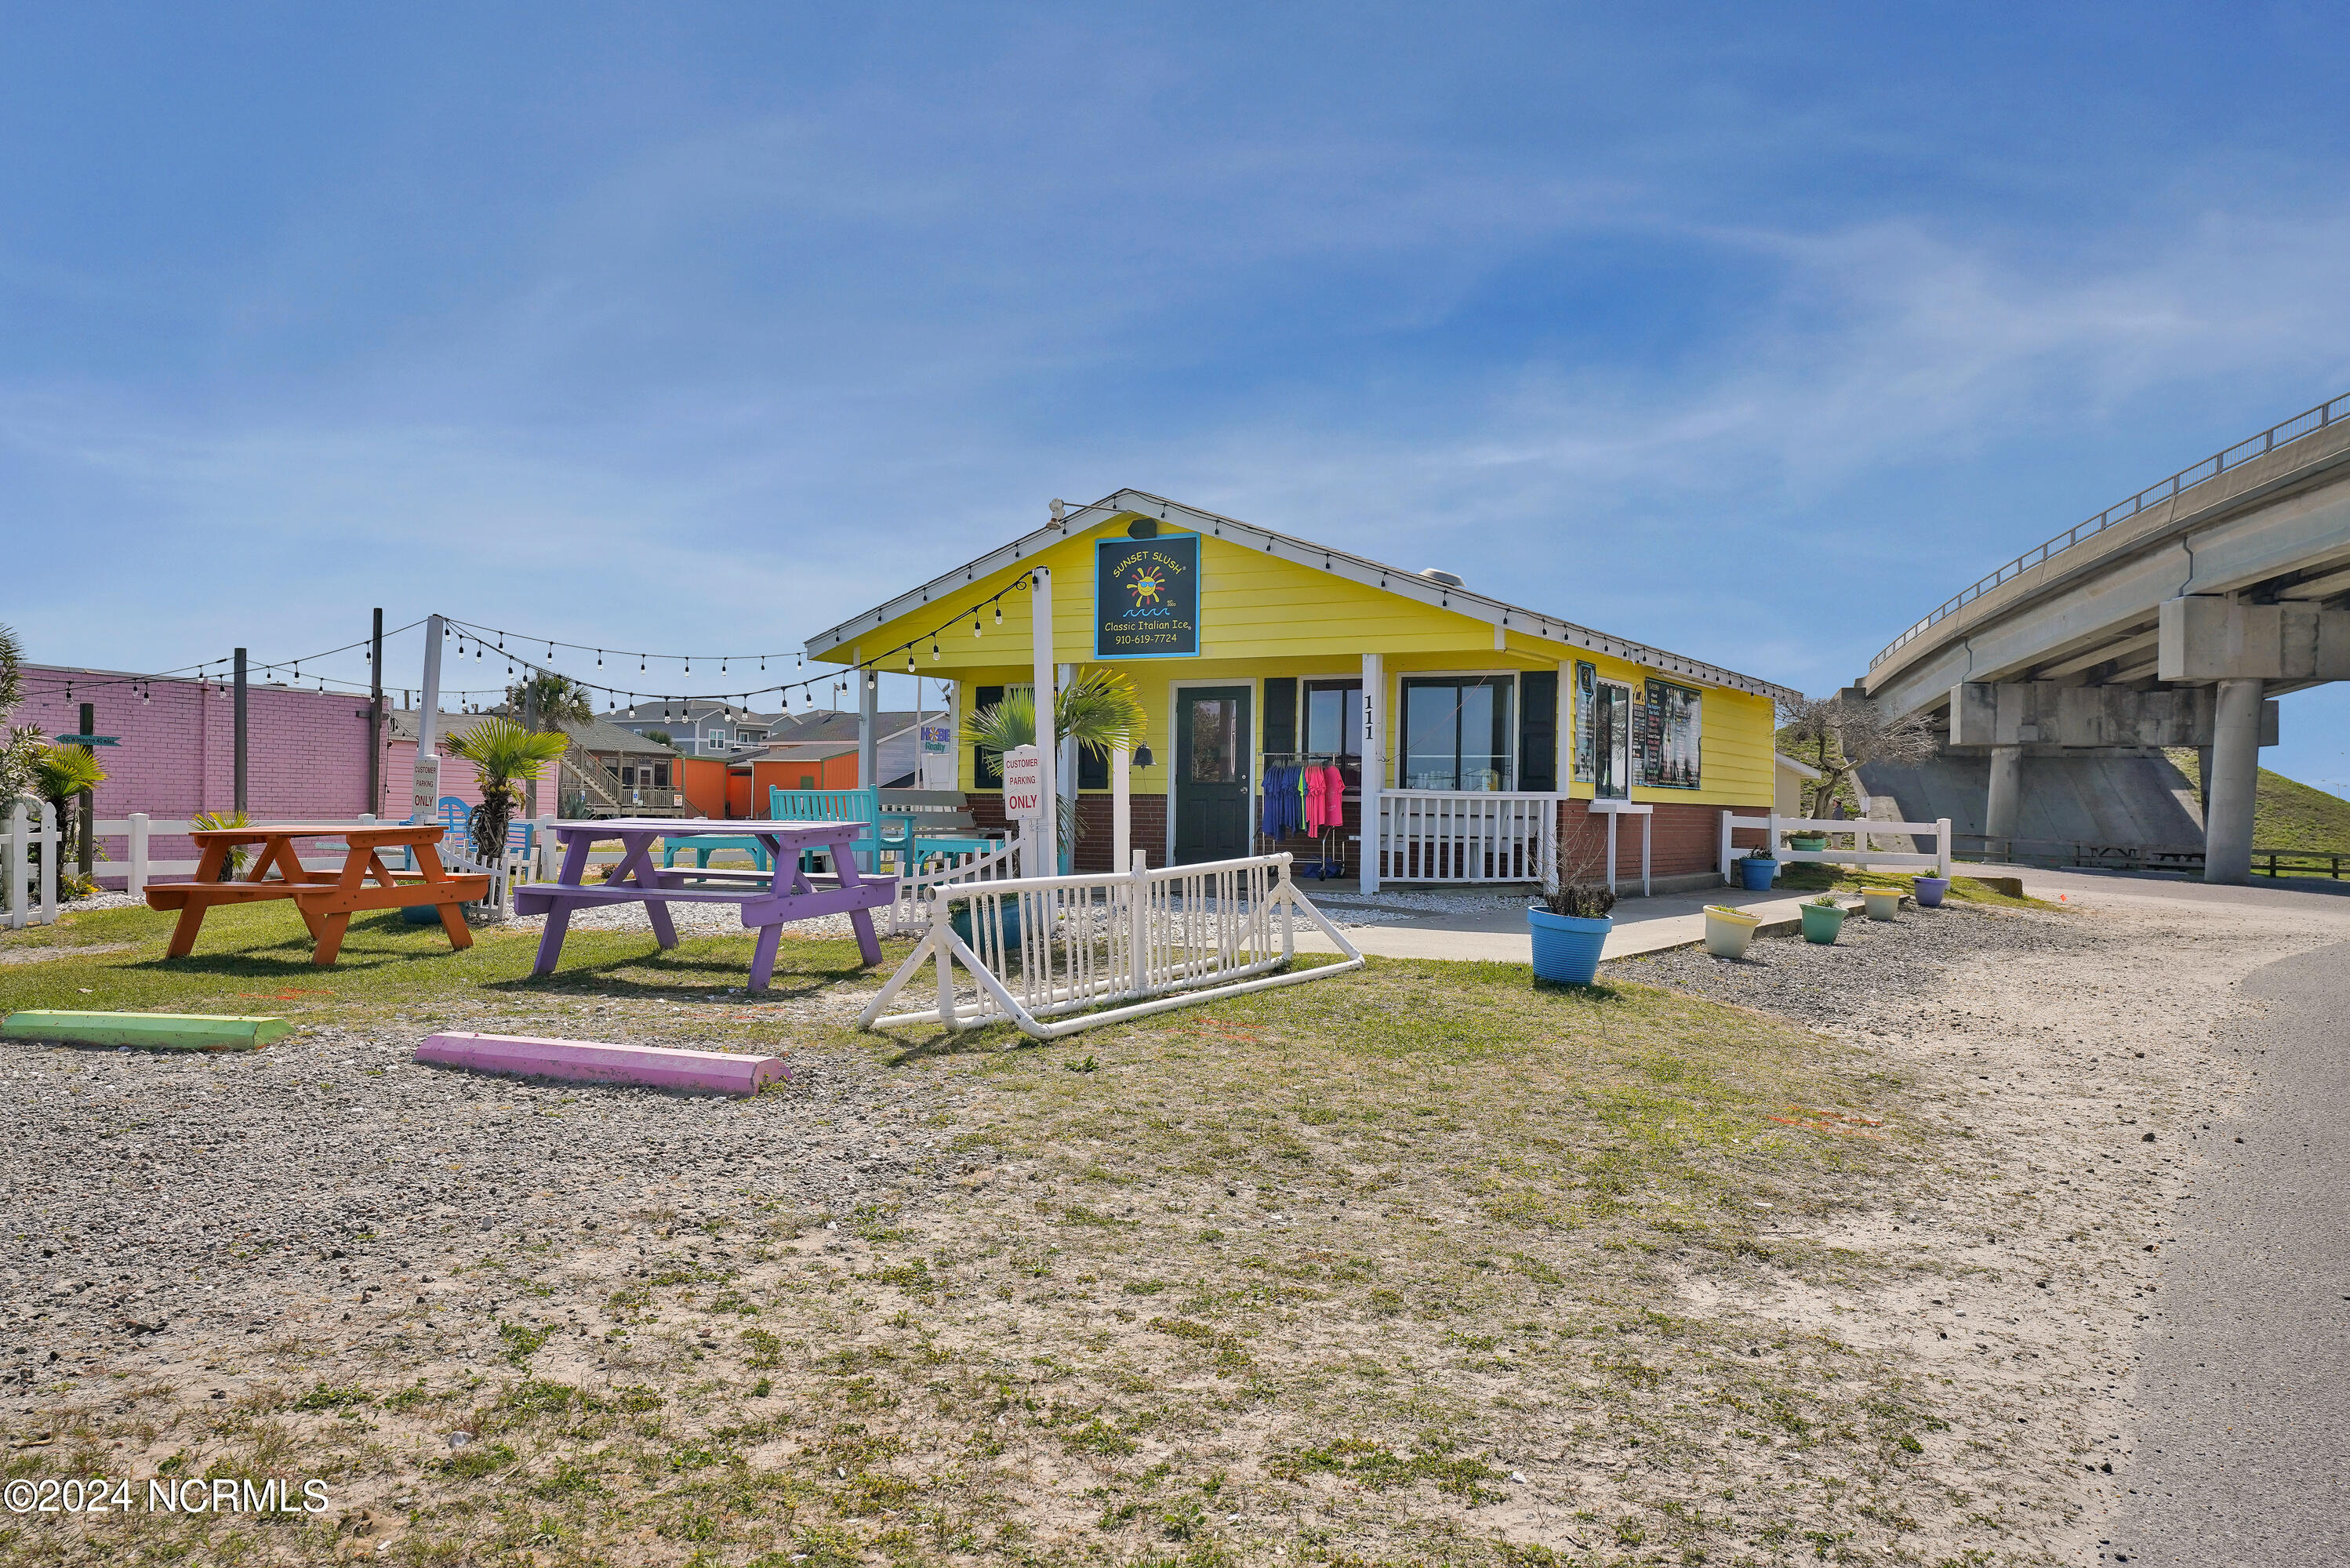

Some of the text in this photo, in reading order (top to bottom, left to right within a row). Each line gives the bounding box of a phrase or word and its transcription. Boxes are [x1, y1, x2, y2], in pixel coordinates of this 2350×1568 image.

[1113, 551, 1149, 578] SUNSET
[1105, 622, 1135, 631] Classic
[1138, 620, 1169, 630] Italian
[1115, 633, 1177, 644] 910-619-7724
[1364, 695, 1373, 740] 111
[925, 741, 946, 753] Realty
[1006, 758, 1038, 768] CUSTOMER
[416, 779, 434, 788] PARKING
[1009, 775, 1036, 786] PARKING
[414, 794, 434, 807] ONLY
[1009, 794, 1037, 809] ONLY
